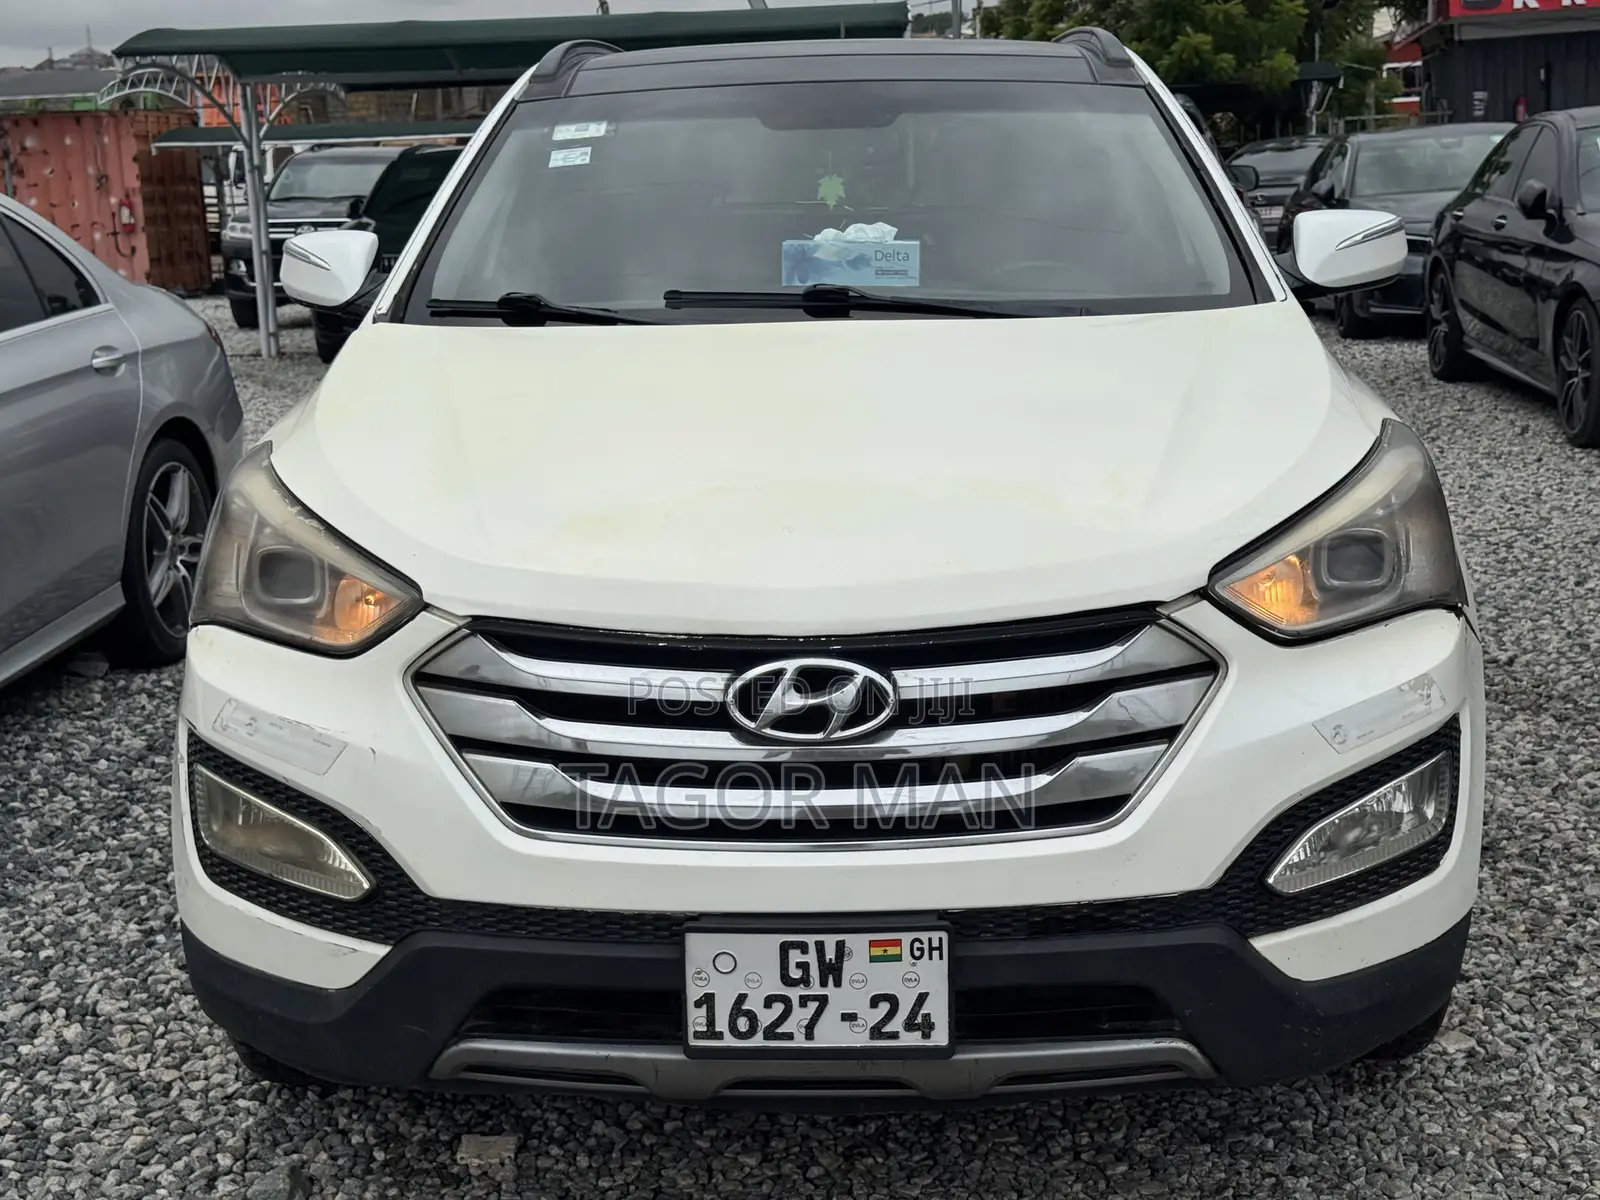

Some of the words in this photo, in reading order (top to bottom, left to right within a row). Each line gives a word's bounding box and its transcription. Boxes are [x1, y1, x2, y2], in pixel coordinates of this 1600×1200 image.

[874, 249, 910, 262] Delta
[779, 939, 846, 988] GW
[909, 936, 944, 961] GH
[693, 991, 936, 1041] 1627-24
